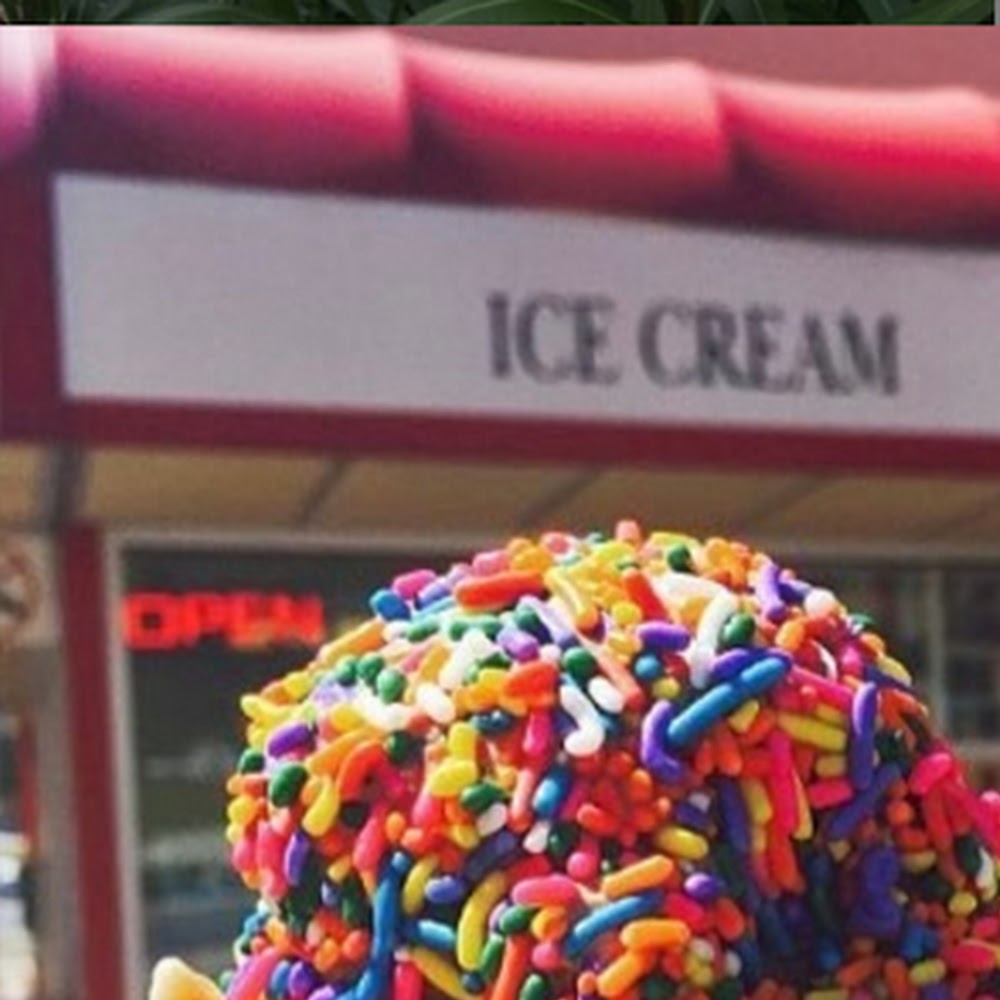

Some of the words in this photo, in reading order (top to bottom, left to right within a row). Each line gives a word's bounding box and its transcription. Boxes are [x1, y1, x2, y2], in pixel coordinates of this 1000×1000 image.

[487, 291, 621, 386] ICE
[638, 298, 900, 397] CREAM
[124, 591, 323, 650] OPEN
